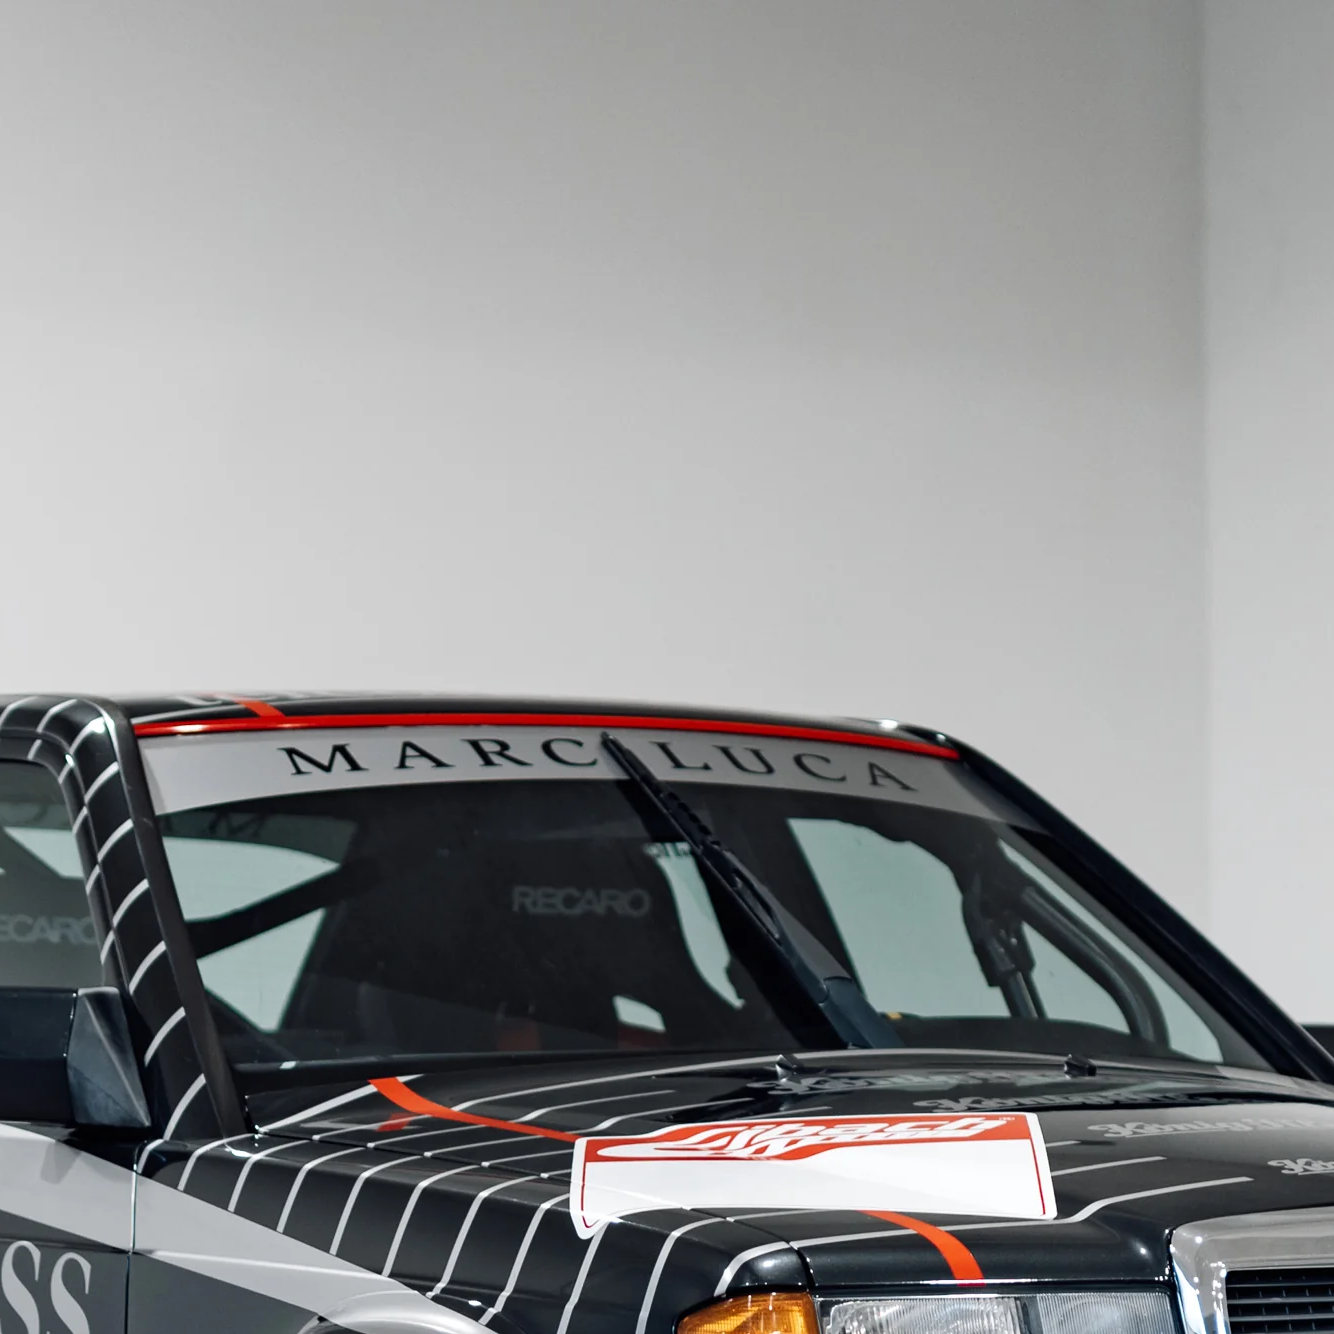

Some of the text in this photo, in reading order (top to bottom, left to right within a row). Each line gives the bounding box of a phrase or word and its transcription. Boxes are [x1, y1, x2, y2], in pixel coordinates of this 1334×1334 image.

[277, 737, 920, 793] MARC LUCA
[512, 885, 650, 918] RECARO
